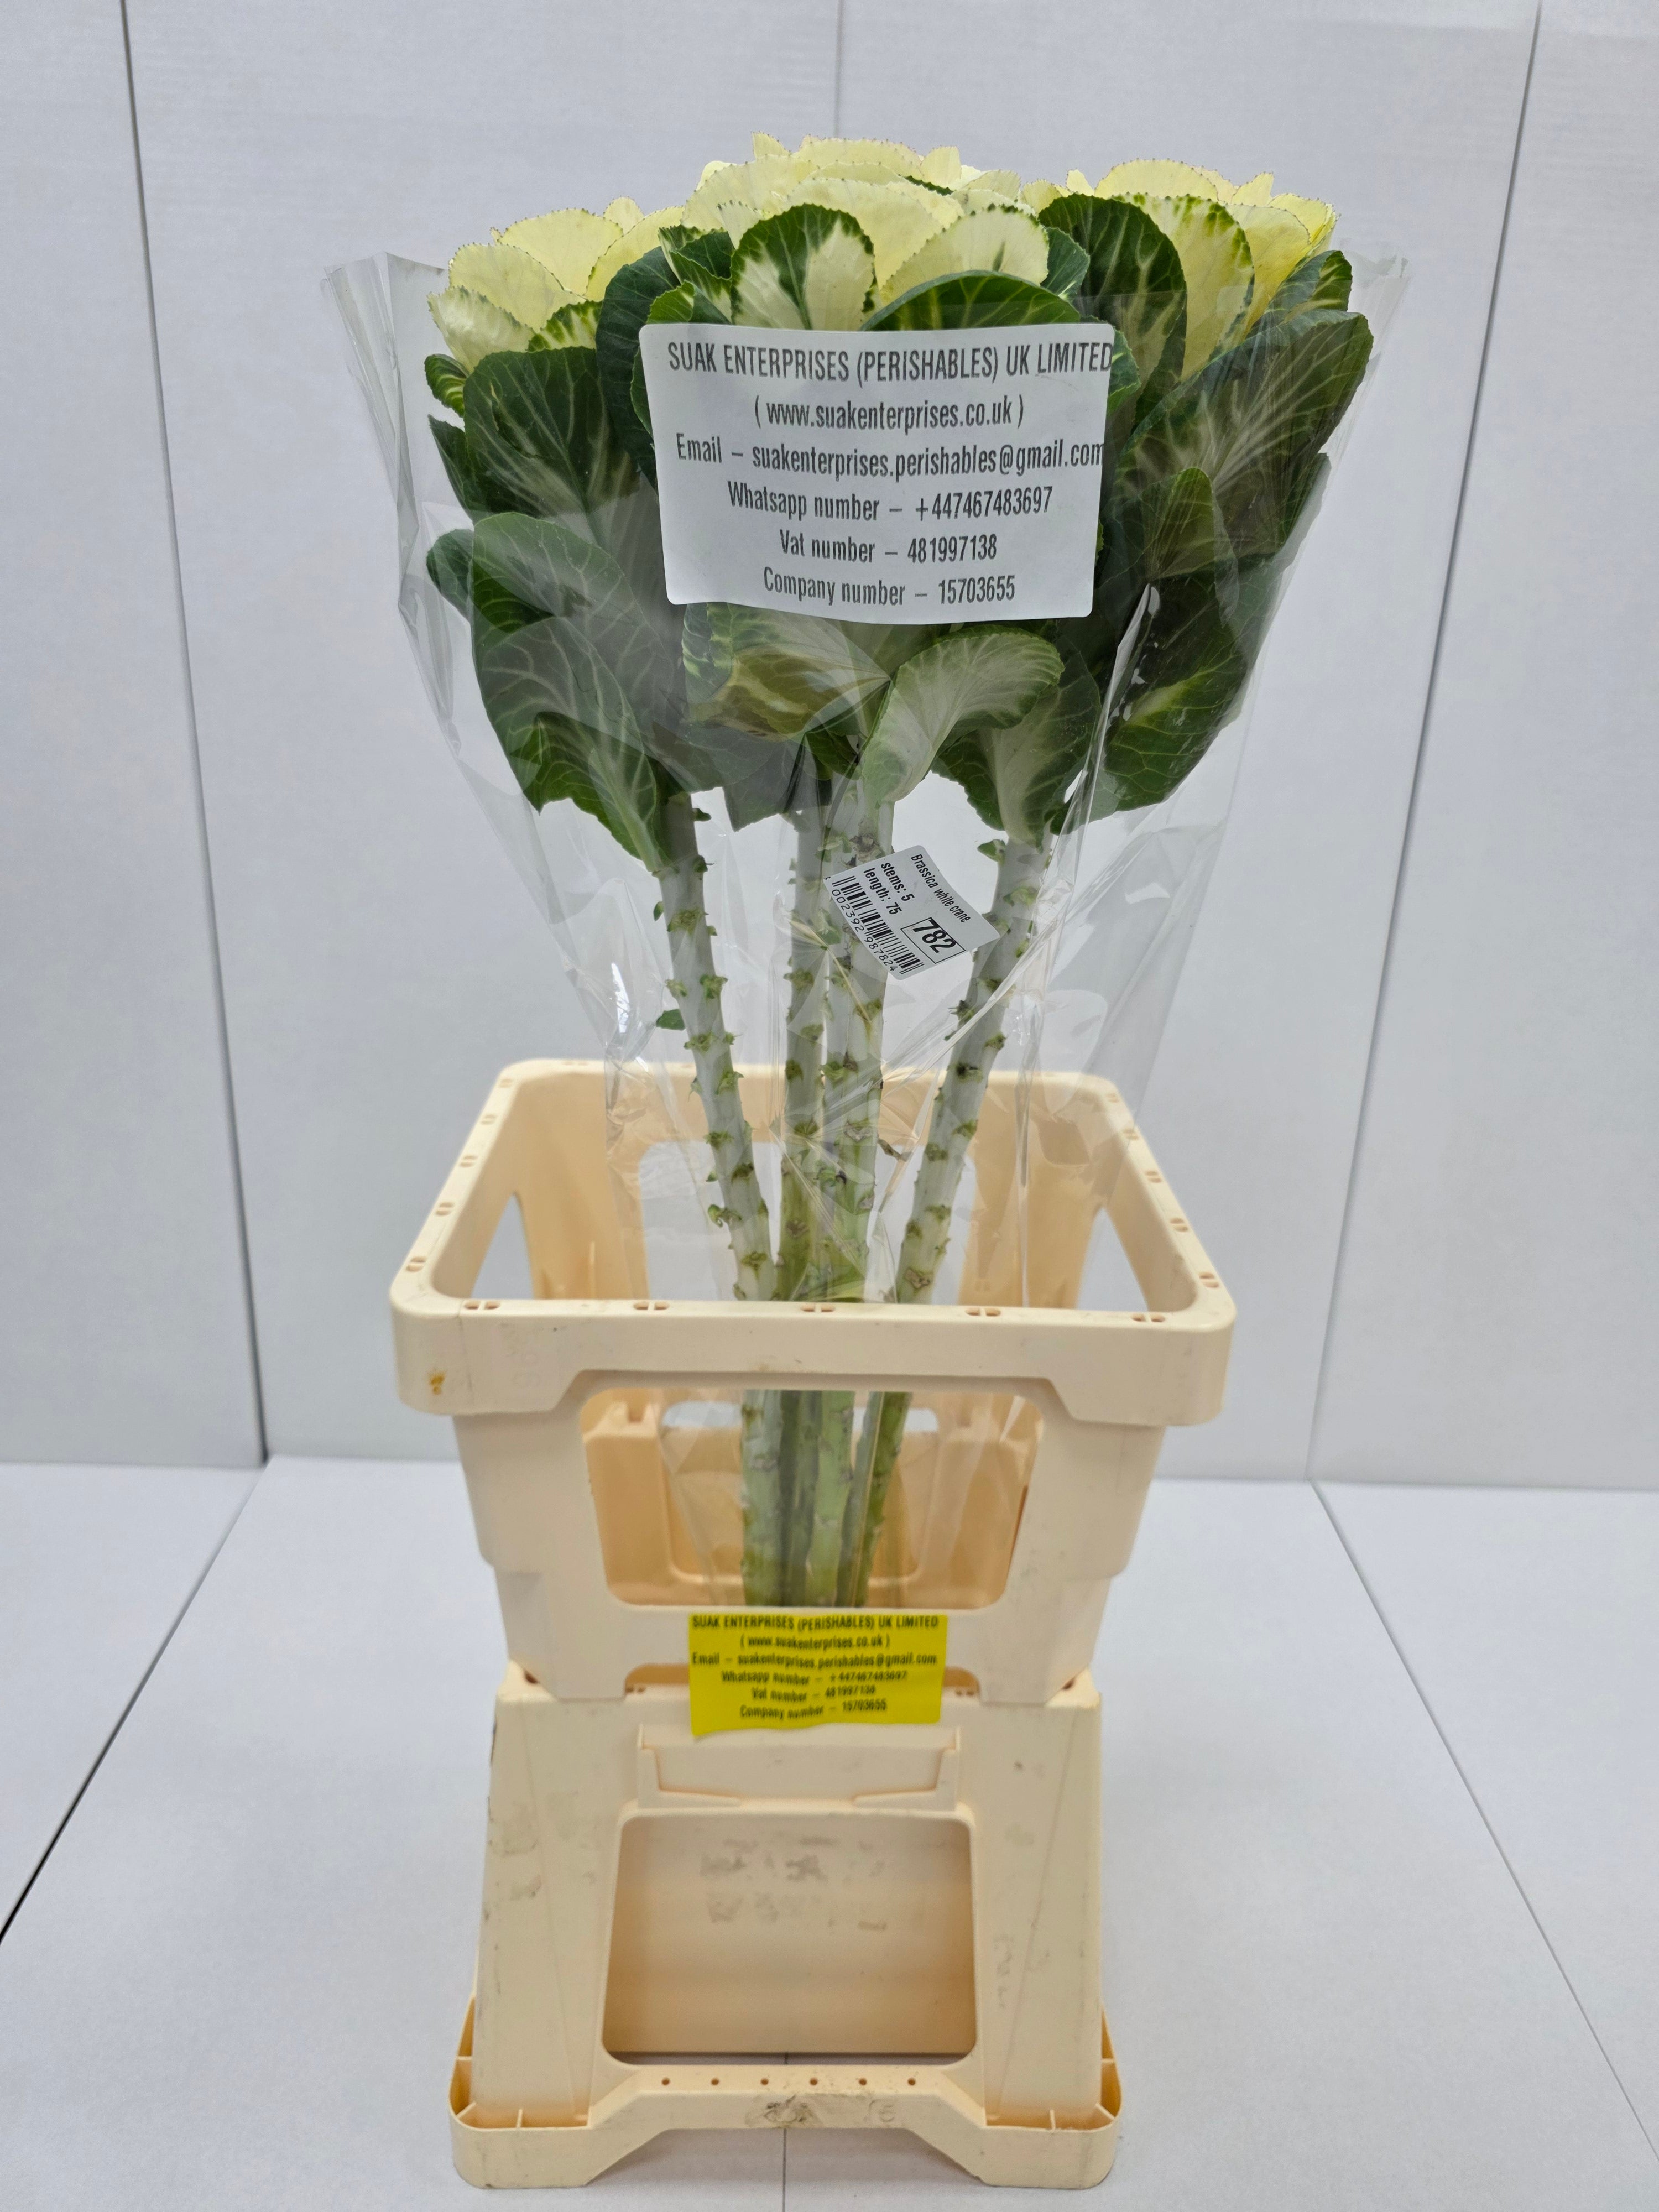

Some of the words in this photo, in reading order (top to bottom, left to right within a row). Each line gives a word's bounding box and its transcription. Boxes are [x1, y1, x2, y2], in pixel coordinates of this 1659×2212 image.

[667, 342, 717, 372] SUAK
[723, 344, 849, 382] ENTERPRISES
[857, 346, 998, 388] (PERISHABLES)
[1006, 345, 1031, 377] UK
[1037, 342, 1113, 373] LIMITED
[766, 395, 1012, 436] www.suakenterprises.co.uk
[676, 432, 722, 463] Email
[727, 481, 807, 521] Whatsapp
[814, 494, 880, 521] number
[915, 486, 1053, 521] +447467483697
[779, 529, 805, 557] Vat
[811, 536, 875, 563] number
[907, 533, 997, 564] 481997138
[764, 566, 836, 606] Company
[842, 580, 906, 606] number
[938, 575, 1015, 604] 15703655
[863, 867, 891, 901] length:
[885, 902, 902, 915] 75
[880, 862, 907, 893] stems:
[910, 854, 938, 889] Brassica
[933, 888, 954, 908] white
[949, 906, 971, 923] crane
[912, 919, 956, 954] 782
[693, 1615, 721, 1629] SUAK
[724, 1615, 794, 1629] ENTERPRISES
[797, 1616, 875, 1631] (PERISHABLES)
[878, 1615, 893, 1629] UK
[896, 1615, 938, 1629] LIMITED
